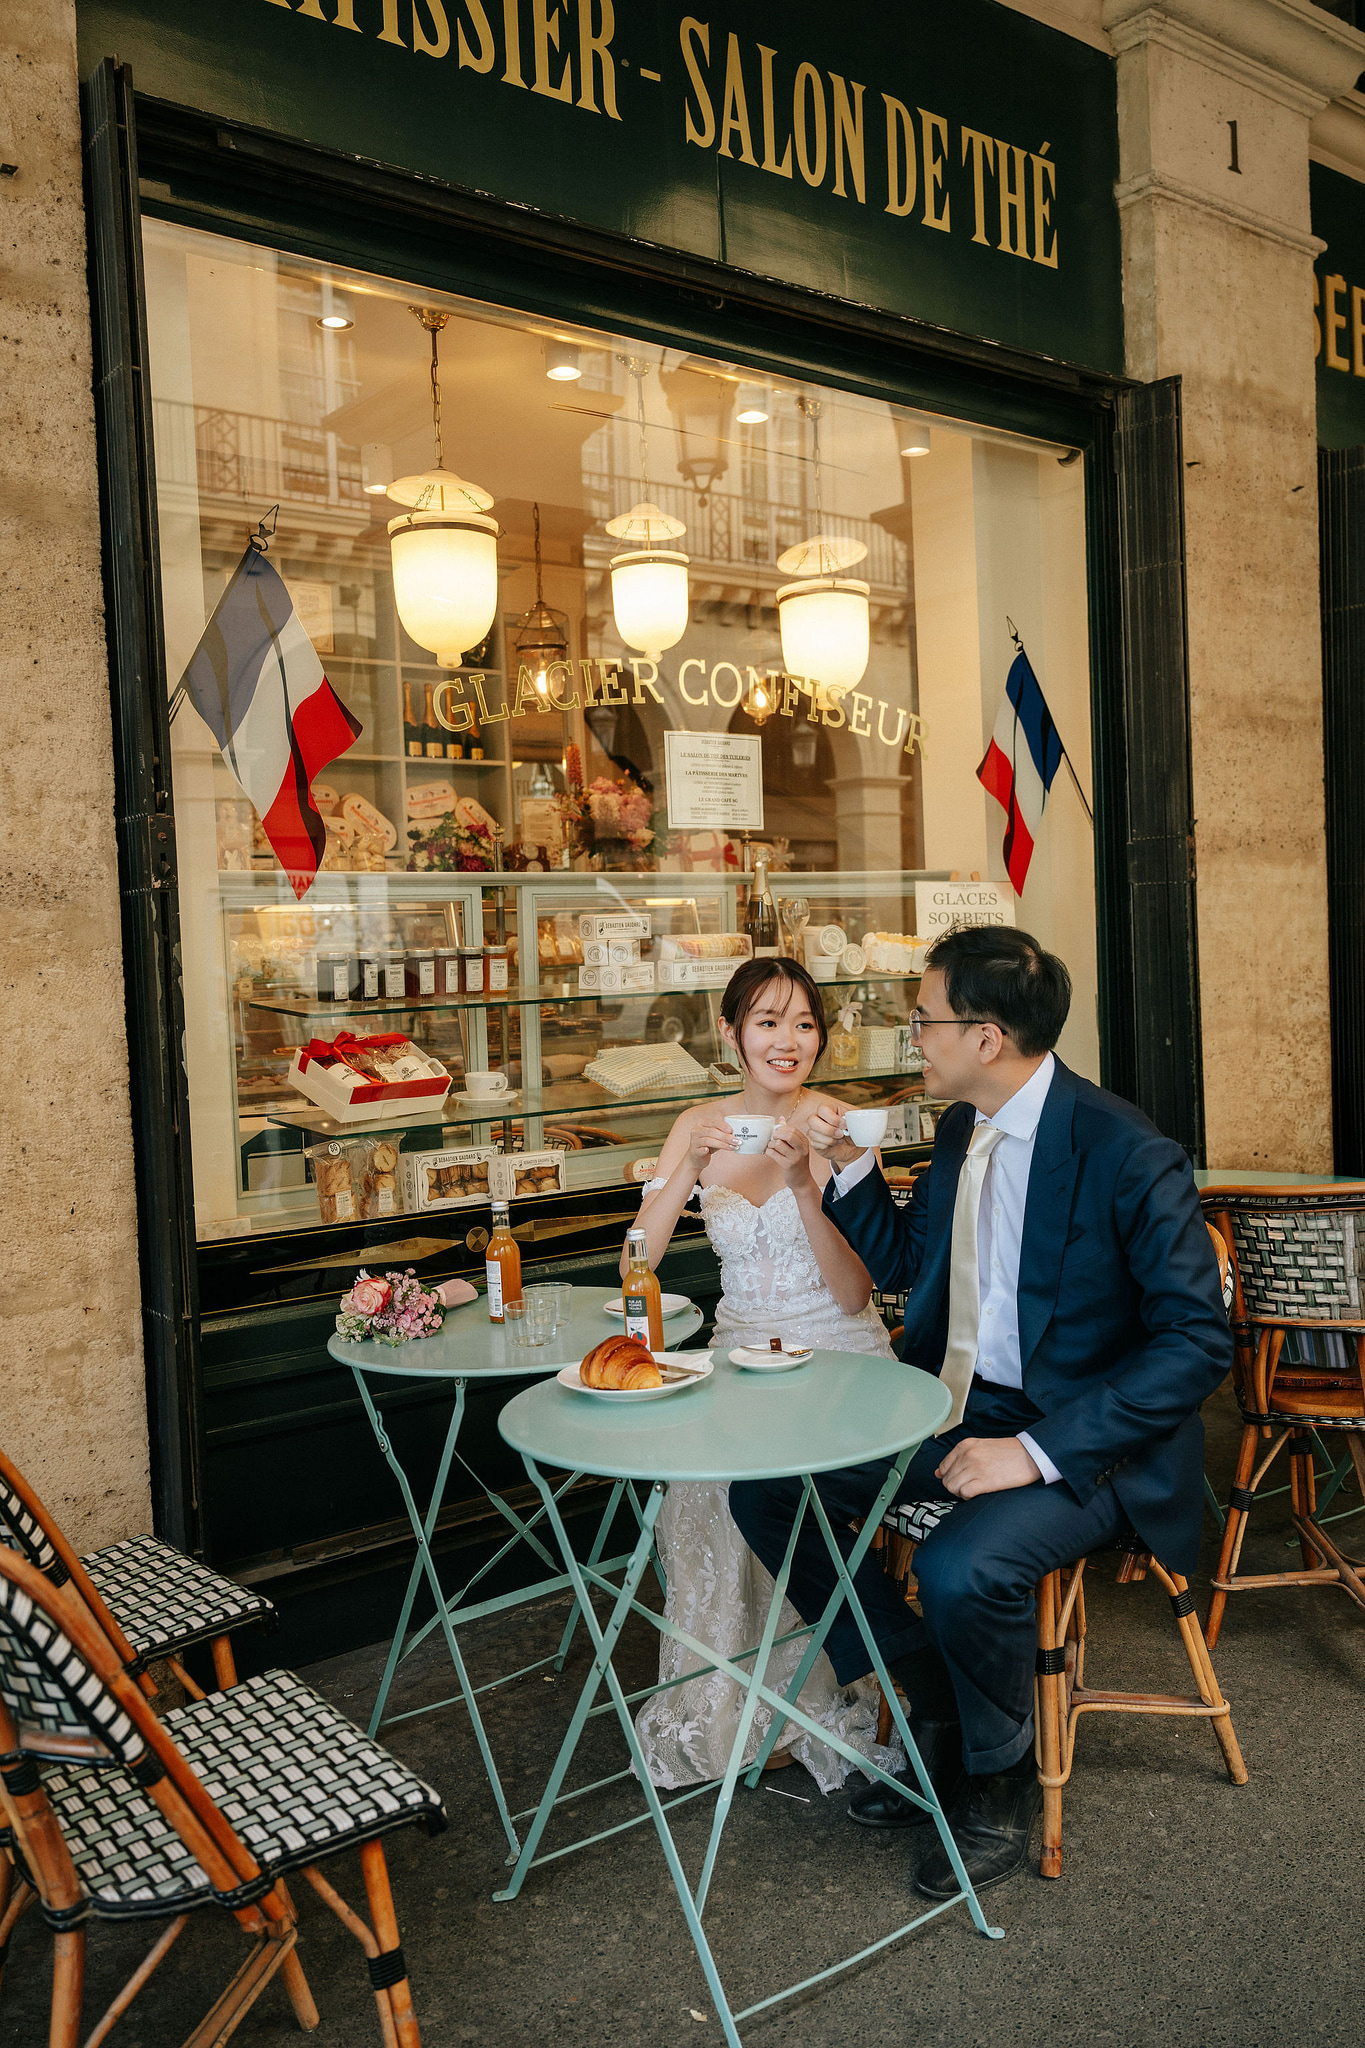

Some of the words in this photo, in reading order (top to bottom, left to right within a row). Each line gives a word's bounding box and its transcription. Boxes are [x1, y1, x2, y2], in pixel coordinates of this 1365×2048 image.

[679, 16, 867, 205] SALON
[881, 92, 951, 233] DE
[961, 126, 1059, 269] THÉ
[1226, 120, 1243, 175] 1
[432, 657, 665, 733] GLACIER
[678, 658, 931, 761] CONFISEUR
[928, 911, 1005, 925] SORBETS
[932, 892, 998, 906] GLACES
